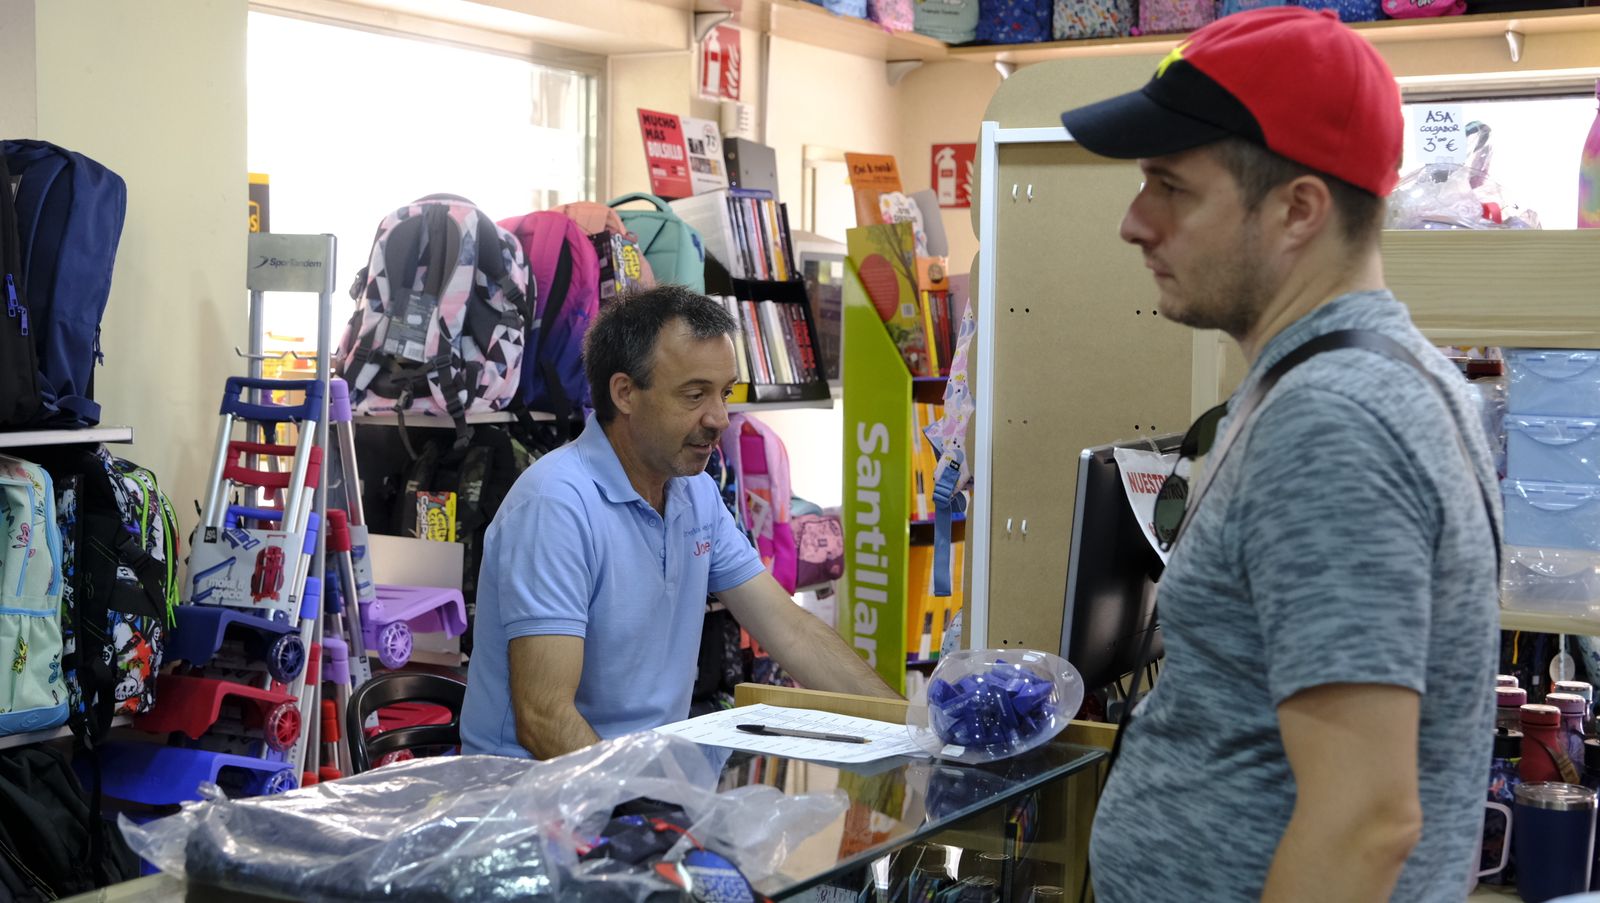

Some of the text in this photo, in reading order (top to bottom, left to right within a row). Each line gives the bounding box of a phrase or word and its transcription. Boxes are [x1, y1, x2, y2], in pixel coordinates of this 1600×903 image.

[642, 114, 677, 130] MUCHO
[1425, 110, 1454, 123] ASA
[647, 140, 684, 160] BOLSILLO
[693, 540, 711, 557] Joe
